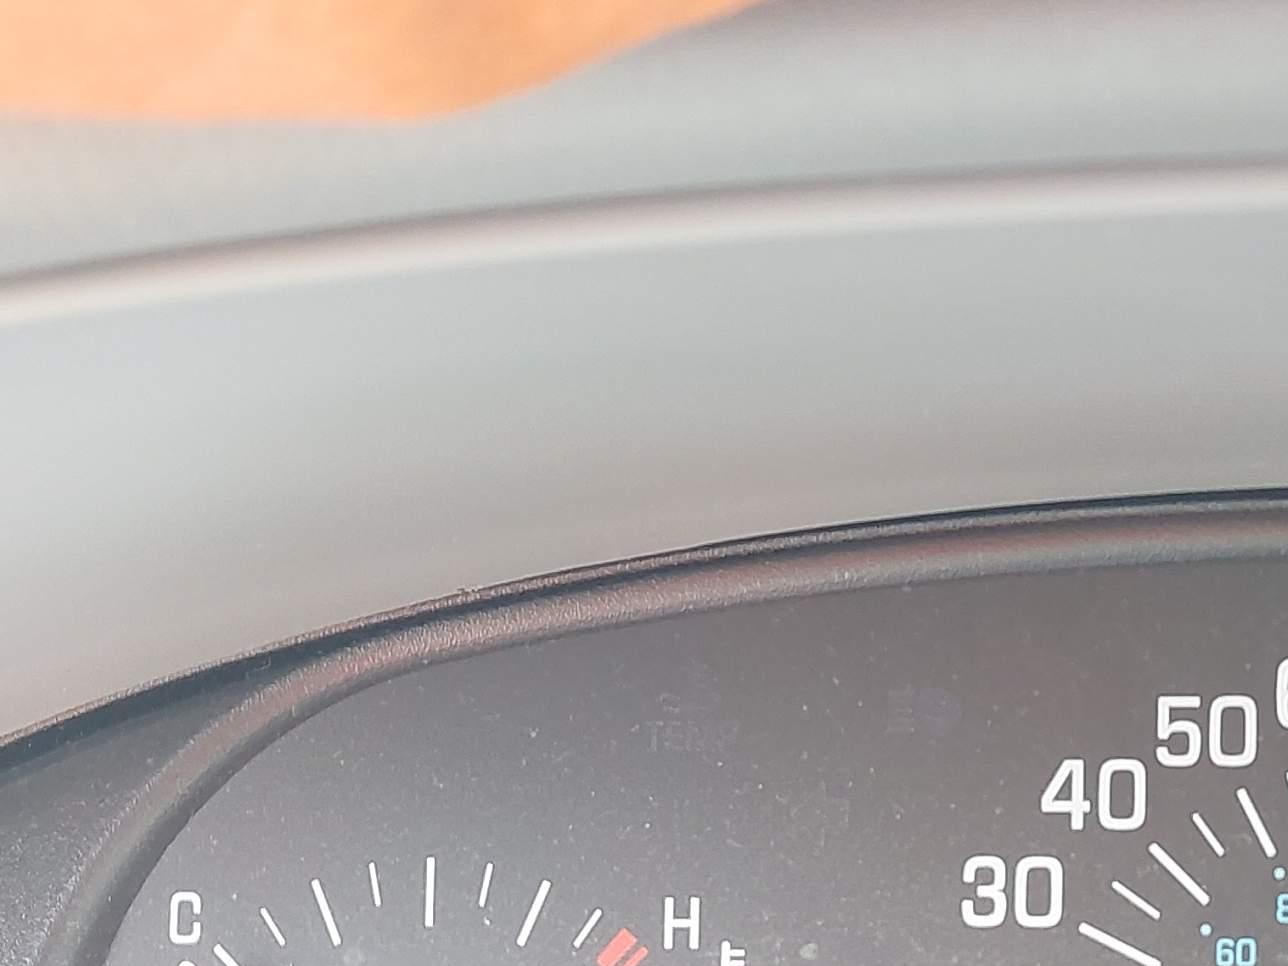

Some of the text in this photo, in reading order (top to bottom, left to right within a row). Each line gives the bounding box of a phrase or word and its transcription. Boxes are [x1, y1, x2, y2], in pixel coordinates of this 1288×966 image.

[1156, 696, 1256, 766] 50
[1041, 759, 1145, 830] 40
[170, 892, 201, 944] C
[664, 897, 699, 949] H
[962, 856, 1062, 927] 30
